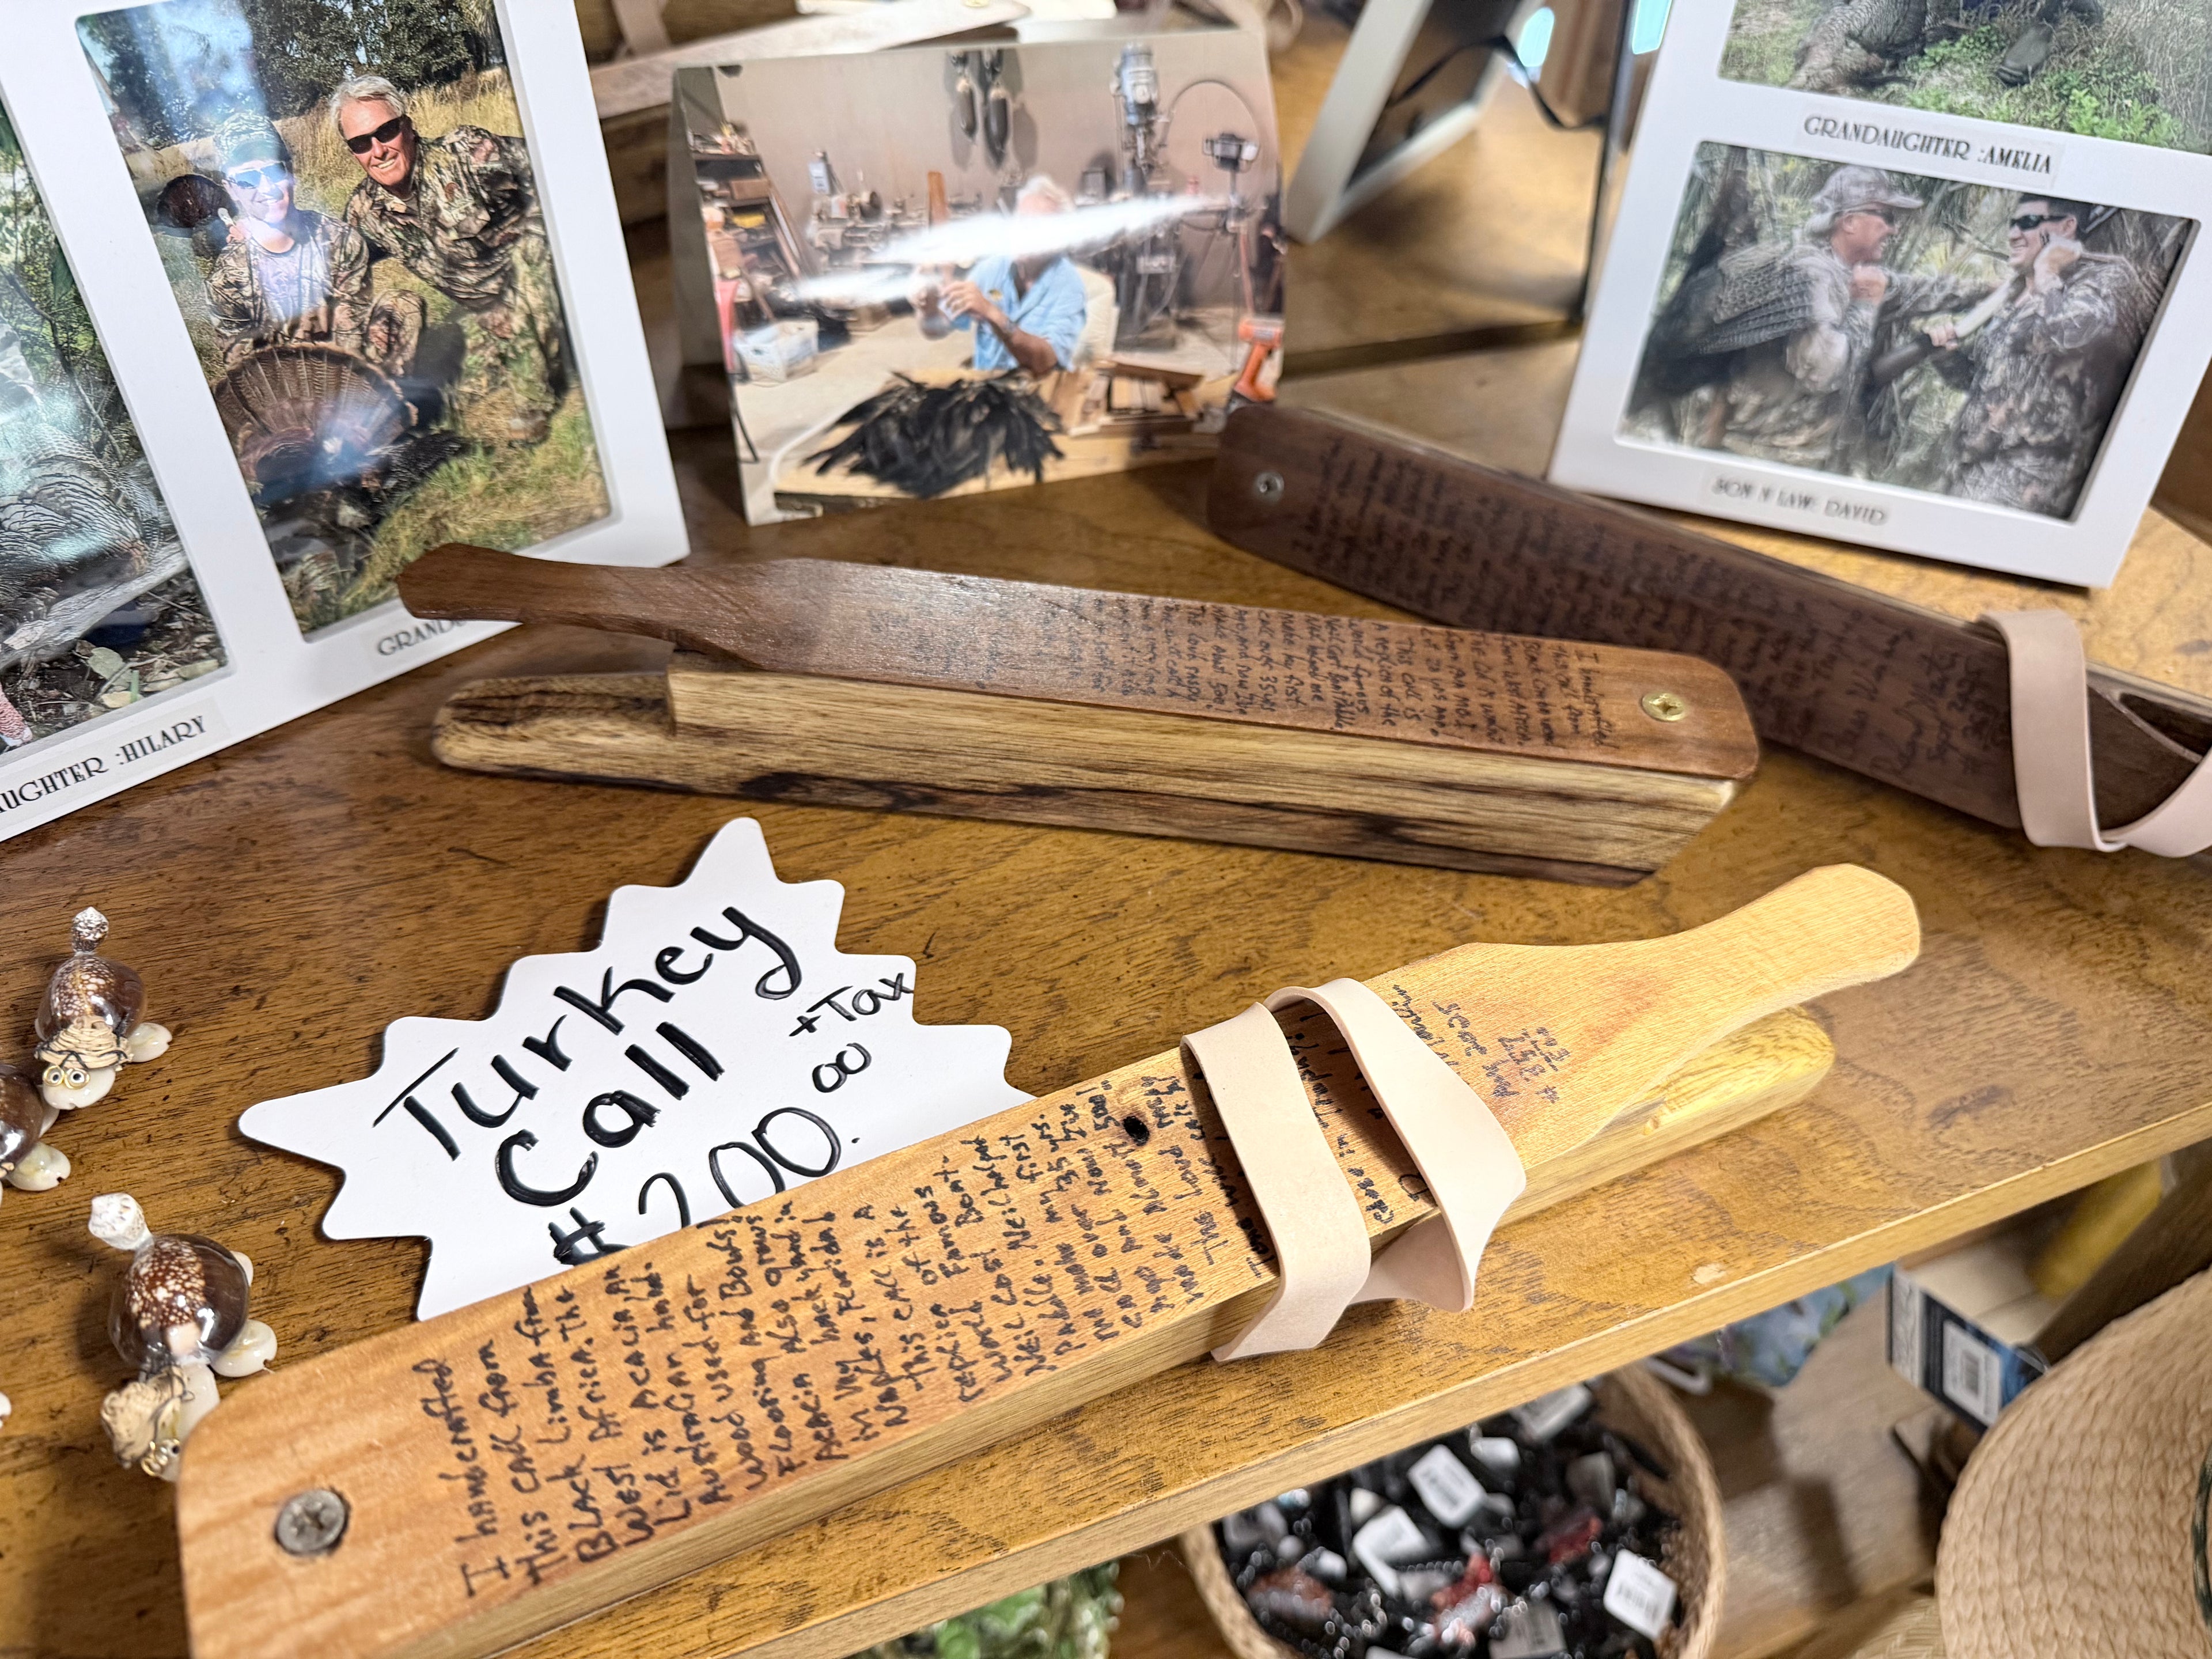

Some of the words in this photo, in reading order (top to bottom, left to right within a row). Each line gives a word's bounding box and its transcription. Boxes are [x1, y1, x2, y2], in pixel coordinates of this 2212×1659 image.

[0, 757, 109, 813] UGHTER
[373, 907, 801, 1160] Turkey
[495, 1021, 724, 1207] Call
[1047, 1157, 1080, 1192] 35
[884, 1206, 921, 1247] the
[864, 1237, 888, 1259] is
[901, 1252, 938, 1285] of
[683, 1274, 715, 1331] for
[642, 1429, 667, 1456] is
[460, 1556, 511, 1599] I
